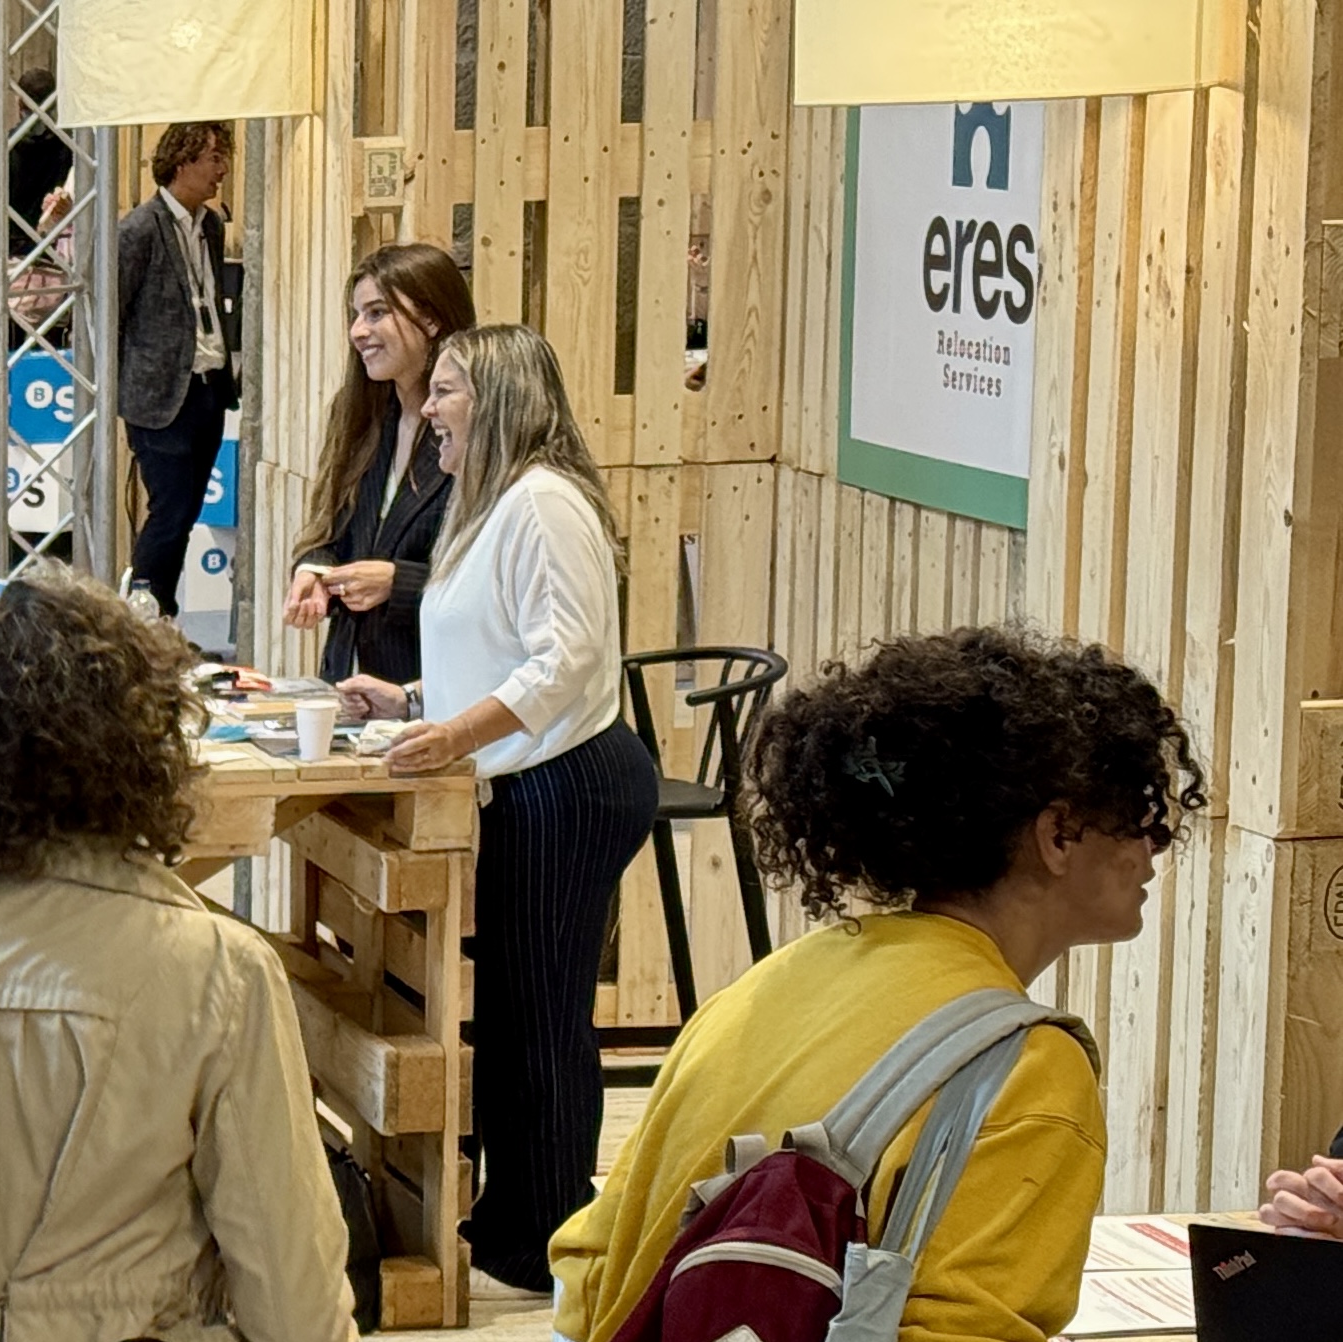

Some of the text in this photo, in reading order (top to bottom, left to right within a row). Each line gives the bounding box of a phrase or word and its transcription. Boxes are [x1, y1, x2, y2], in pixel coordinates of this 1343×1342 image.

[923, 215, 1035, 325] eres
[936, 330, 1011, 366] Relocation
[942, 362, 1003, 398] Services
